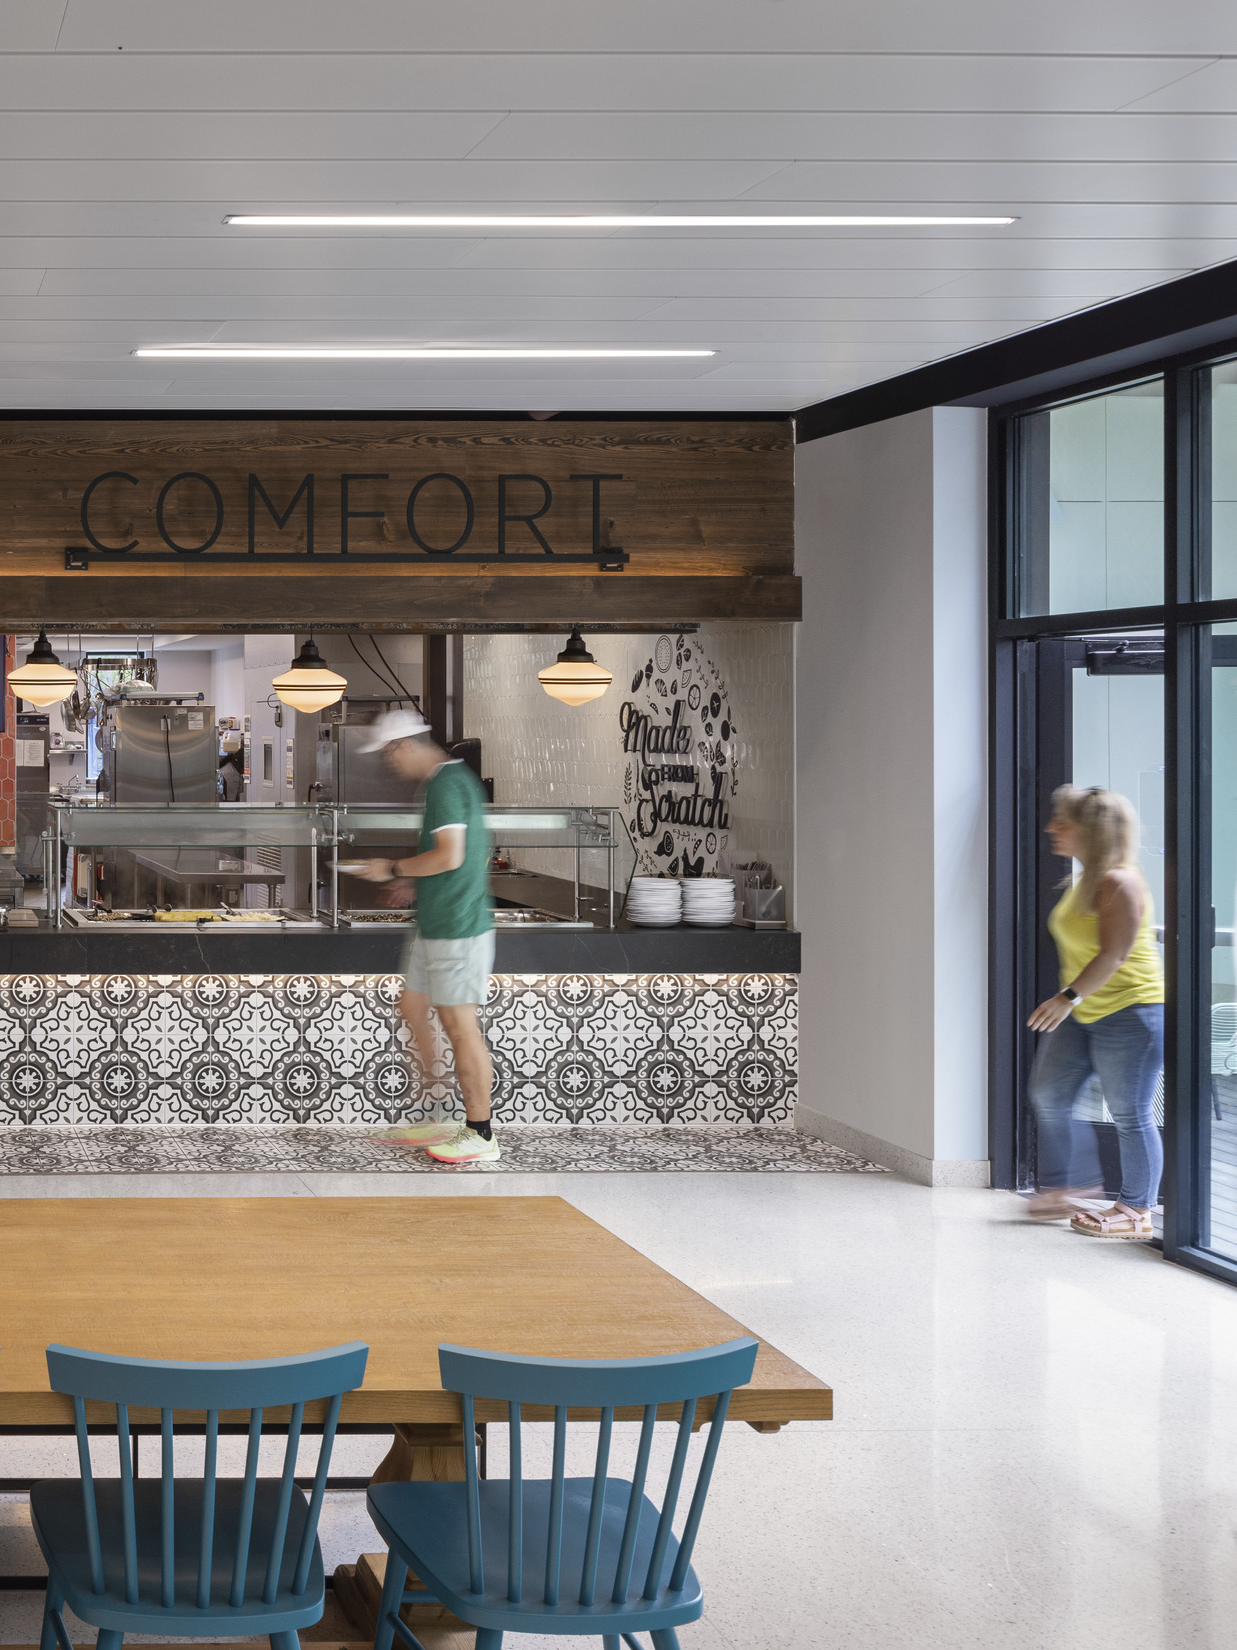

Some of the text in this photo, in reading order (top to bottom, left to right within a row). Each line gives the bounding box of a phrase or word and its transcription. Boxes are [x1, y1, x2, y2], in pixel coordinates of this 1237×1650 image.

[80, 471, 623, 554] COMFORT
[619, 699, 690, 767] Made
[636, 768, 729, 838] Scratch
[660, 764, 694, 783] FROM
